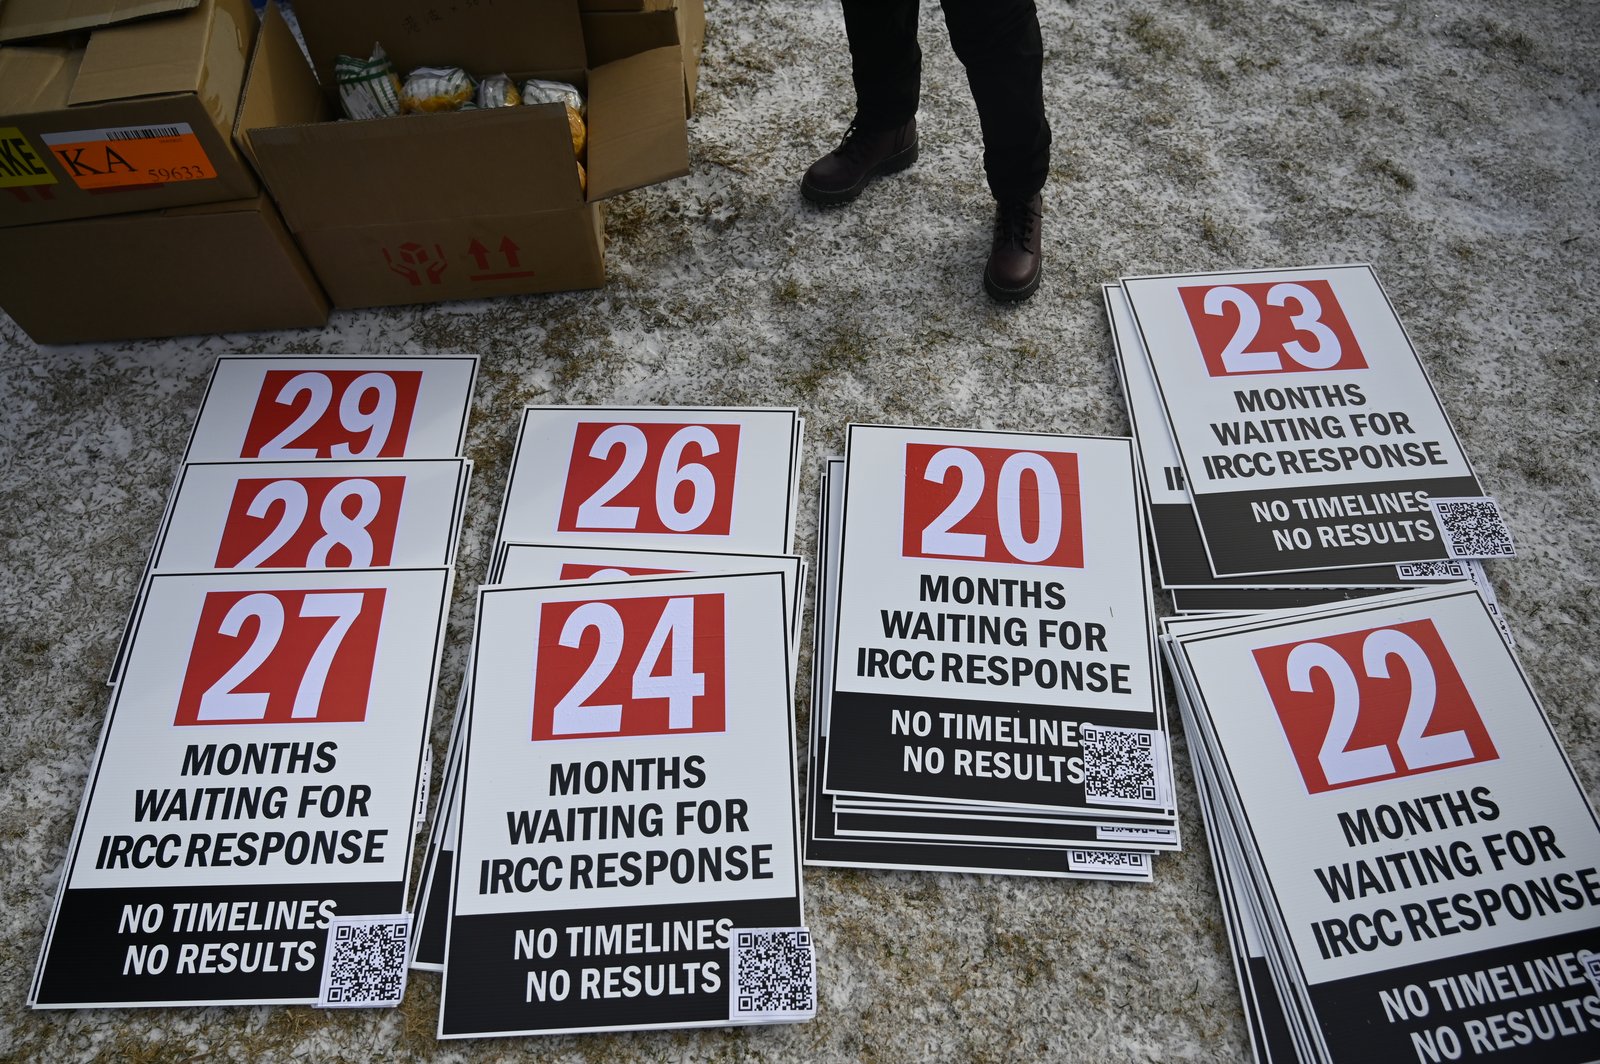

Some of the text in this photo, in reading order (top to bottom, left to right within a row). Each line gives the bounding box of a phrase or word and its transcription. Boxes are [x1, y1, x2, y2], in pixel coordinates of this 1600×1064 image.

[56, 145, 205, 183] KA 59633
[1204, 283, 1342, 372] 23
[259, 372, 397, 457] 29
[1234, 384, 1366, 412] MONTHS
[1210, 412, 1415, 446] WAITING FOR
[576, 425, 719, 531] 26
[1203, 451, 1275, 480] IRCC
[1277, 441, 1448, 474] RESPONSE
[234, 479, 380, 567] 28
[922, 448, 1062, 562] 20
[1251, 491, 1432, 522] NO TIMELINES
[1272, 520, 1434, 551] NO RESULTS
[920, 575, 1065, 610] MONTHS
[881, 610, 1107, 652] WAITING FOR
[197, 593, 365, 720] 27
[553, 597, 704, 735] 24
[857, 648, 1131, 694] IRCC RESPONSE
[892, 710, 931, 736] NO
[1286, 628, 1476, 786] 22
[181, 742, 337, 776] MONTHS
[550, 755, 706, 796] MONTHS
[904, 746, 1085, 785] NO RESULTS
[135, 785, 371, 822] WAITING FOR
[507, 799, 749, 845] WAITING FOR
[1337, 787, 1499, 847] MONTHS
[96, 830, 388, 869] IRCC RESPONSE
[479, 844, 773, 894] IRCC RESPONSE
[1314, 826, 1566, 903] WAITING FOR
[118, 900, 337, 933] NO TIMELINES
[1311, 867, 1600, 959] IRCC RESPONSE
[123, 941, 316, 975] NO RESULTS
[514, 918, 734, 959] NO TIMELINES
[527, 962, 721, 1002] NO RESULTS
[1379, 985, 1429, 1022] NO
[1410, 995, 1600, 1064] NO RESULTS
